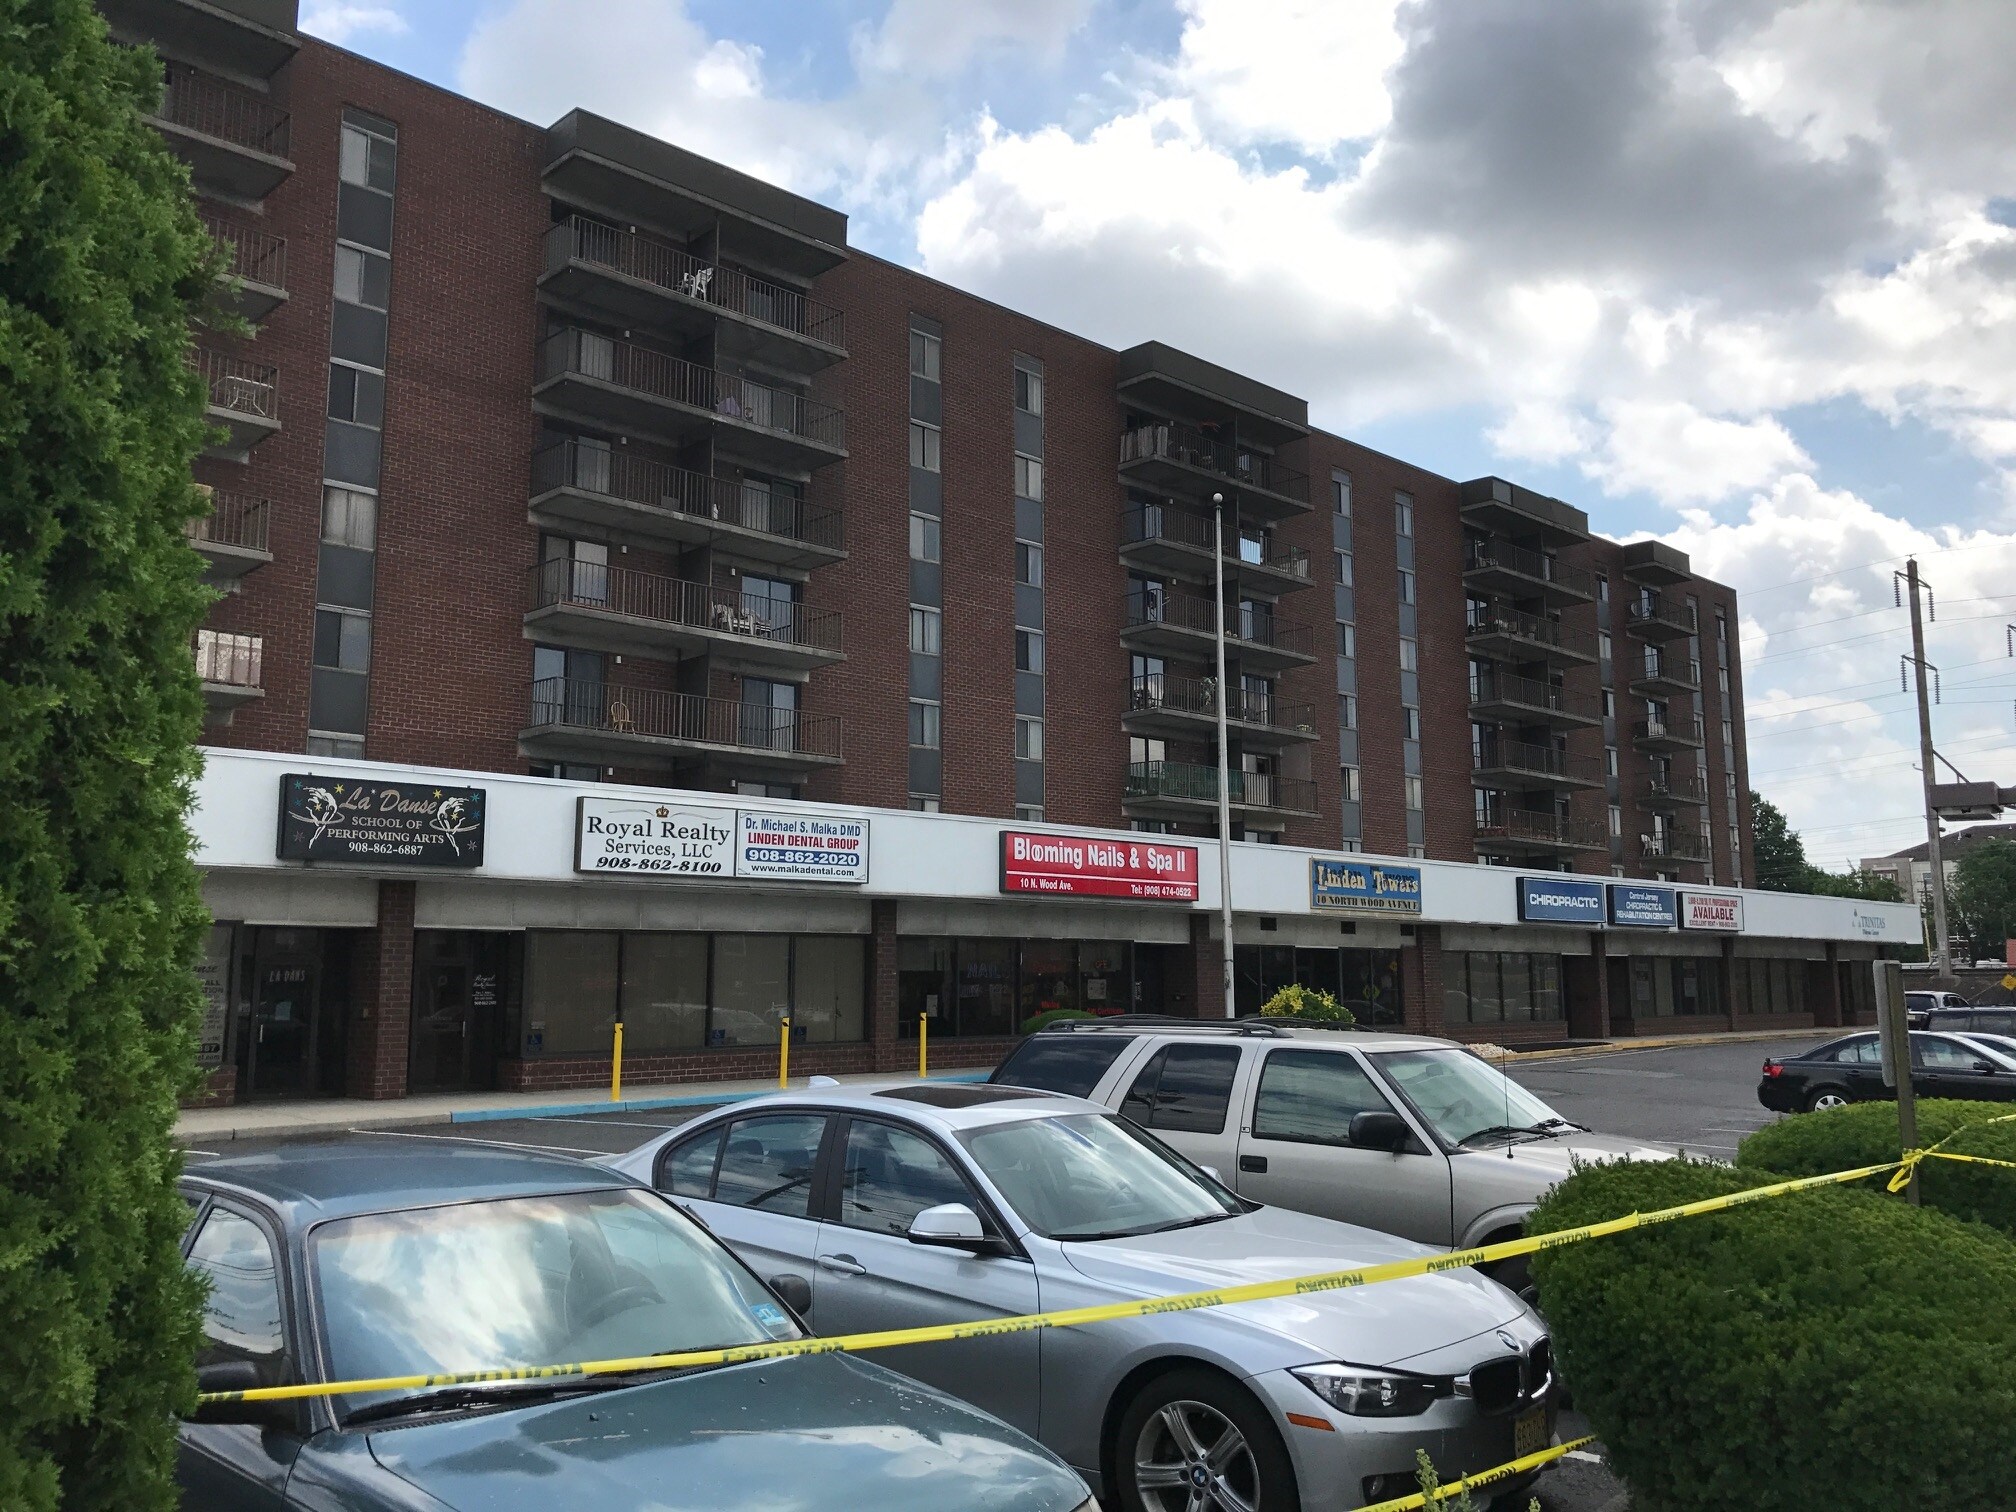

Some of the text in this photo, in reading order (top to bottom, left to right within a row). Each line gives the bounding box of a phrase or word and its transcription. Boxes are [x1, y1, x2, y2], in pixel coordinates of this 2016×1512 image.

[339, 786, 437, 815] La Danse
[351, 816, 422, 830] SCHOOL OF
[587, 816, 731, 846] Royal Realty
[745, 817, 861, 836] Dr. Michael S. Malka DMD
[327, 828, 444, 844] PERFORMING ARTS
[748, 832, 859, 850] LINDEN DENTAL GROUP
[348, 842, 423, 856] 908-862-6887
[605, 838, 713, 858] Services, LLC
[1014, 837, 1083, 869] Blooming
[1088, 844, 1125, 868] Nails
[1129, 847, 1140, 868] &
[1147, 848, 1173, 874] Spa
[596, 856, 722, 873] 908-862-8100
[749, 849, 858, 866] 908-862-2020
[751, 865, 854, 876] www.malkadental.com
[1020, 877, 1073, 891] 10 N. Wood Ave.
[1317, 865, 1419, 894] Linden Towers
[1131, 884, 1142, 895] Tel:
[1162, 885, 1191, 897] 474-0522
[1317, 895, 1419, 910] 10 NORTH WOOD AVENUE
[1530, 893, 1599, 909] CHIROPRACTIC
[1626, 901, 1658, 911] CHIROPRACTIC
[1616, 910, 1652, 920] REHABILITATION
[1693, 906, 1734, 920] AVAILABLE
